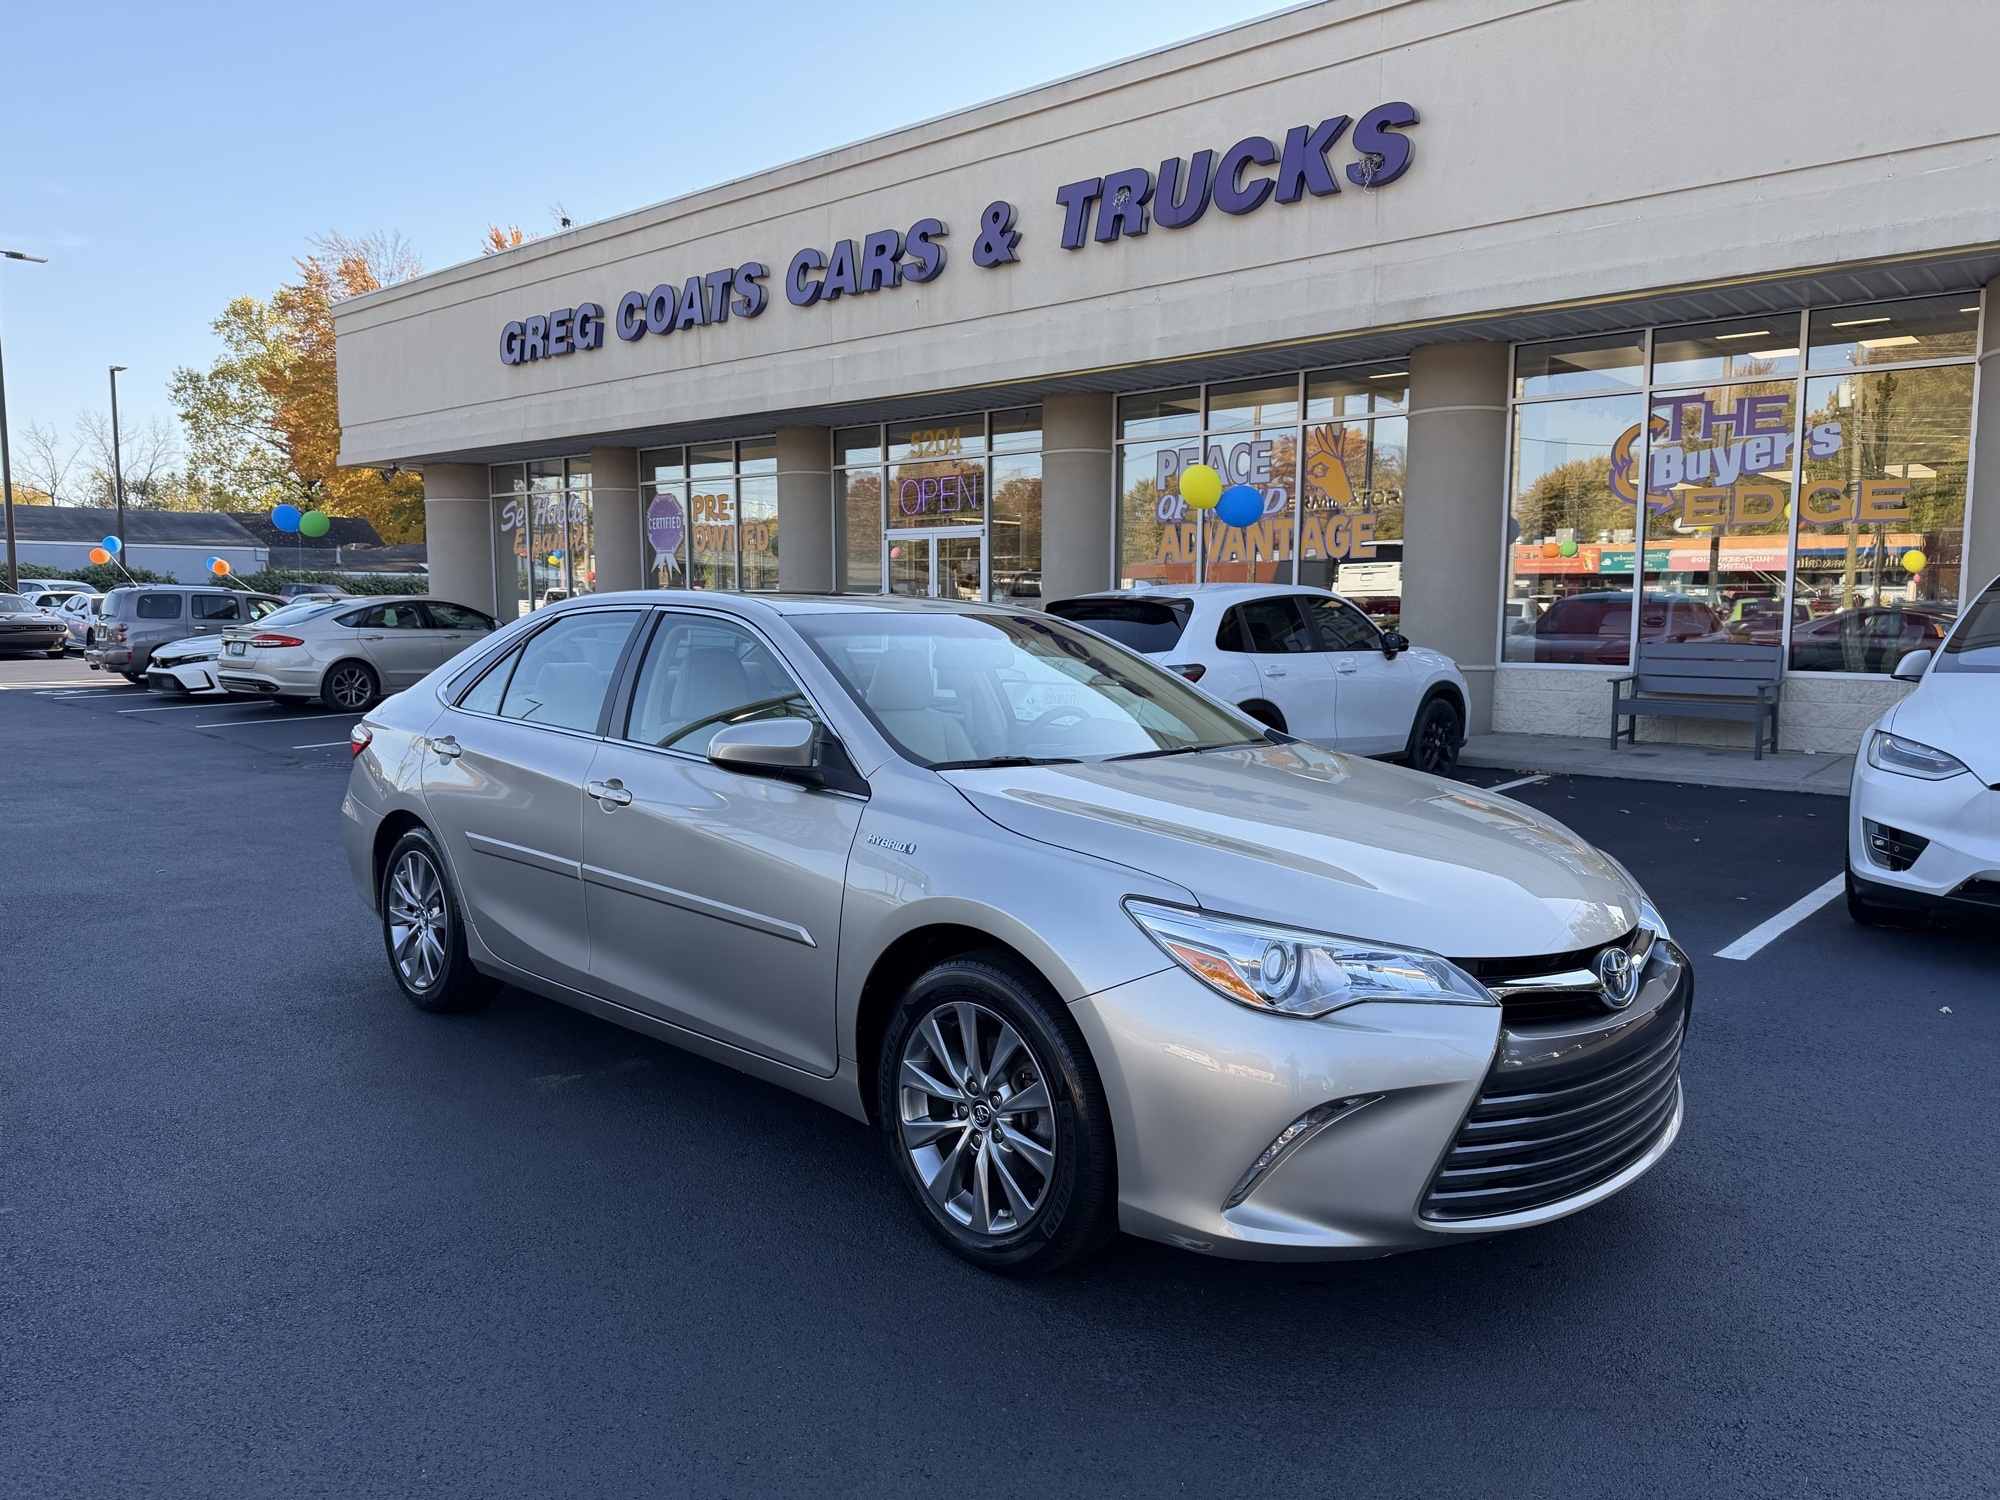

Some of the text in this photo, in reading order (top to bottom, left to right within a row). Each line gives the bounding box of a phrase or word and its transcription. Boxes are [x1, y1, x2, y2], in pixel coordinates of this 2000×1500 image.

[500, 101, 1420, 366] GREG COATS CARS & TRUCKS
[1652, 392, 1790, 443] THE
[910, 427, 963, 458] 5204
[1650, 421, 1843, 490] Buyer's
[501, 494, 588, 532] Se Habla
[692, 494, 734, 522] PRE-
[900, 474, 977, 515] OPEN
[1681, 478, 1911, 528] EDGE
[648, 516, 682, 531] CERTIFIED
[693, 524, 769, 553] OWNED
[1156, 513, 1377, 565] ADVANTAGE
[867, 834, 907, 852] HYBRID
